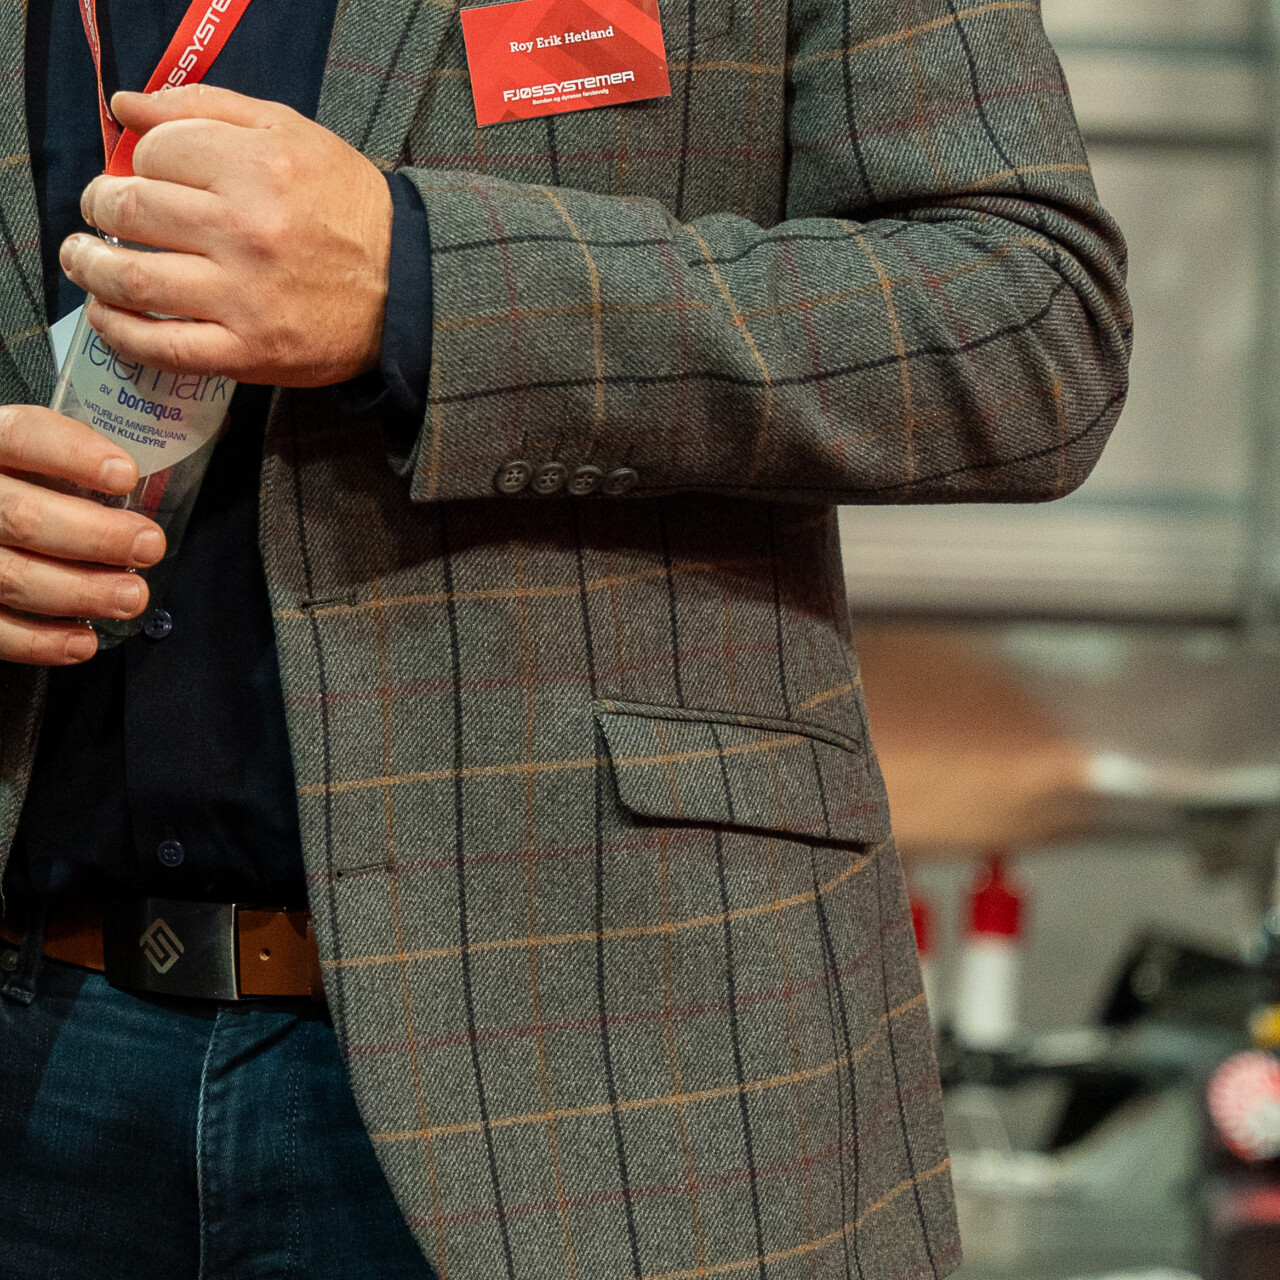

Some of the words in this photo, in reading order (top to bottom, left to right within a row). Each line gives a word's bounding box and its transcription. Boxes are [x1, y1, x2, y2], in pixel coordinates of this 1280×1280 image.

[509, 41, 534, 53] Roy
[536, 35, 562, 48] Erik
[564, 25, 615, 44] Hetland
[503, 70, 635, 102] FJØSSYSTEMER
[99, 384, 113, 395] av
[83, 398, 124, 425] NATURLIG
[125, 419, 187, 441] MINERALVANN
[92, 415, 116, 433] UTEN
[117, 427, 167, 448] KULLSYRE
